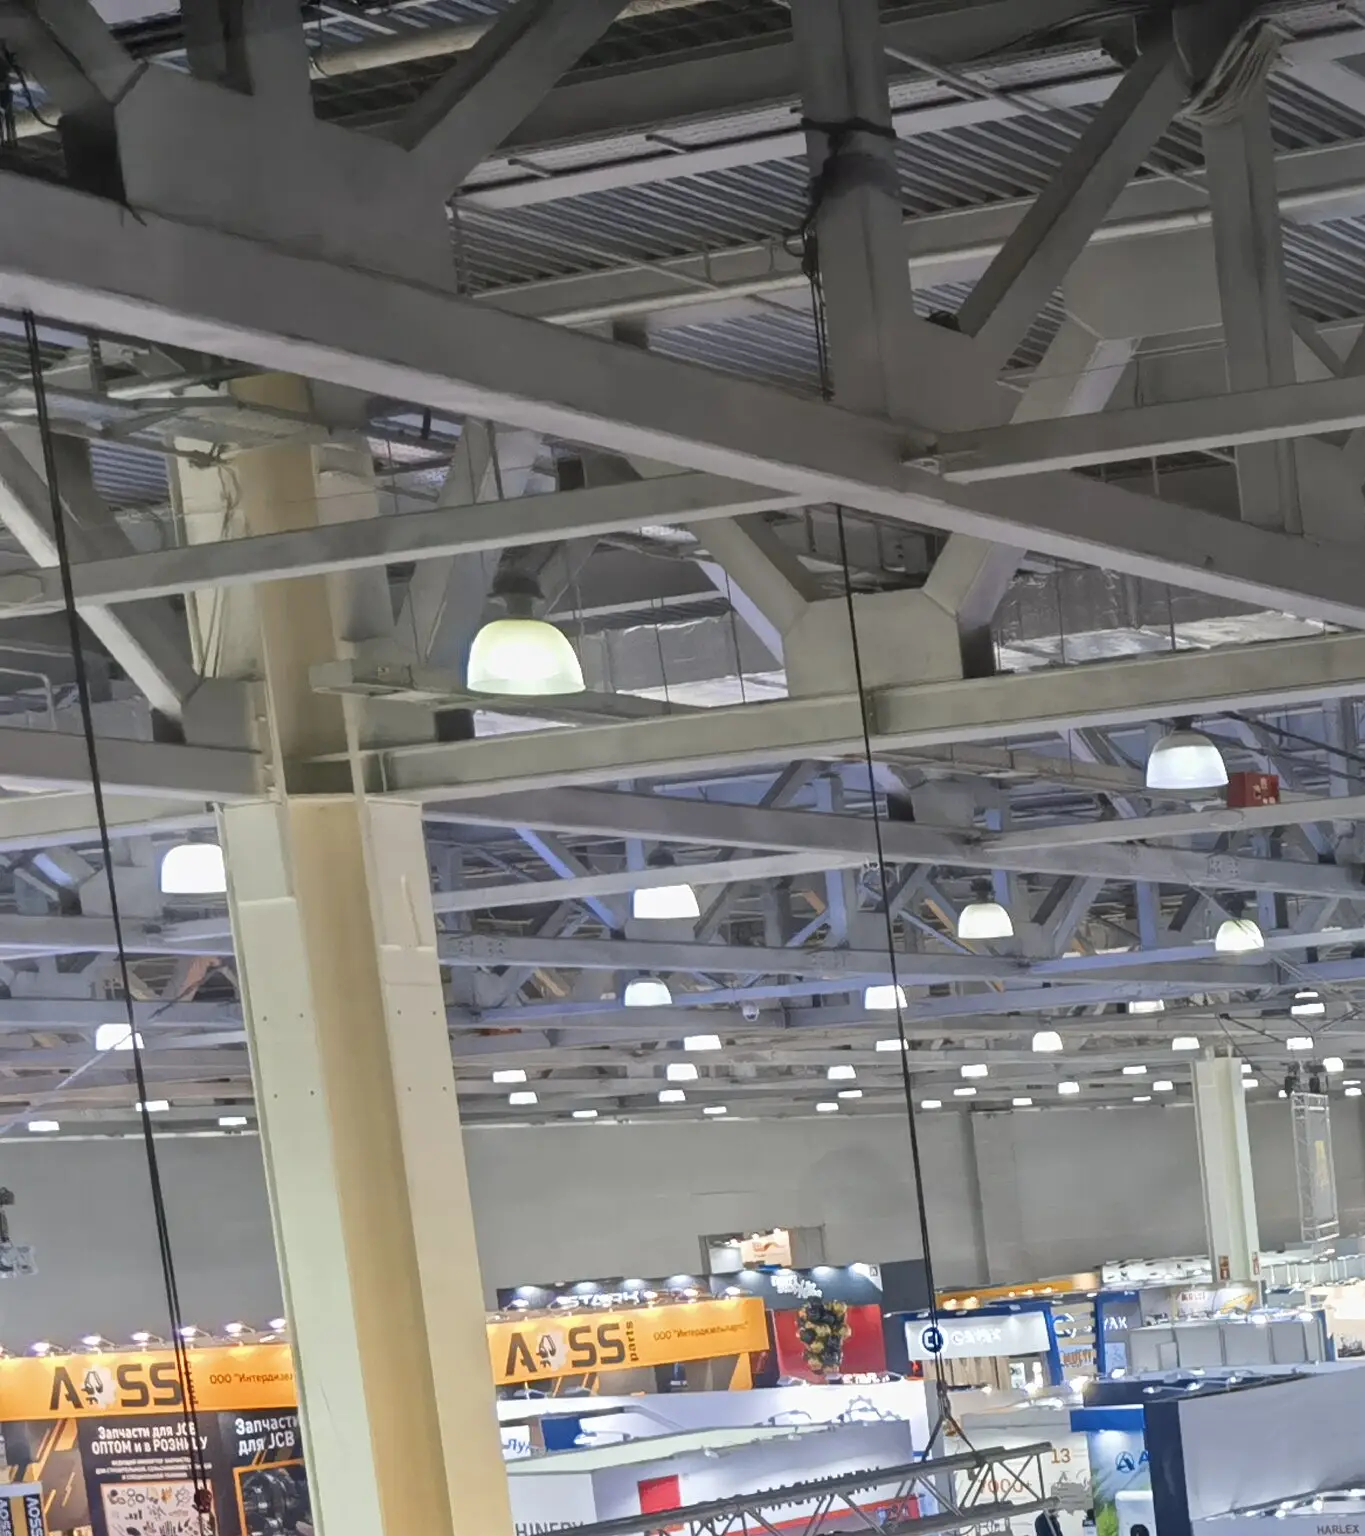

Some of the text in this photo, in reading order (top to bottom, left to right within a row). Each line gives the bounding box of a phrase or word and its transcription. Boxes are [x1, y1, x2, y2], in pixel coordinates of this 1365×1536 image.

[98, 1426, 150, 1440] Запчасти
[152, 1425, 174, 1440] для
[91, 1440, 133, 1455] ОПТОМ
[239, 1431, 295, 1456] для JCB
[1051, 1447, 1070, 1464] 13
